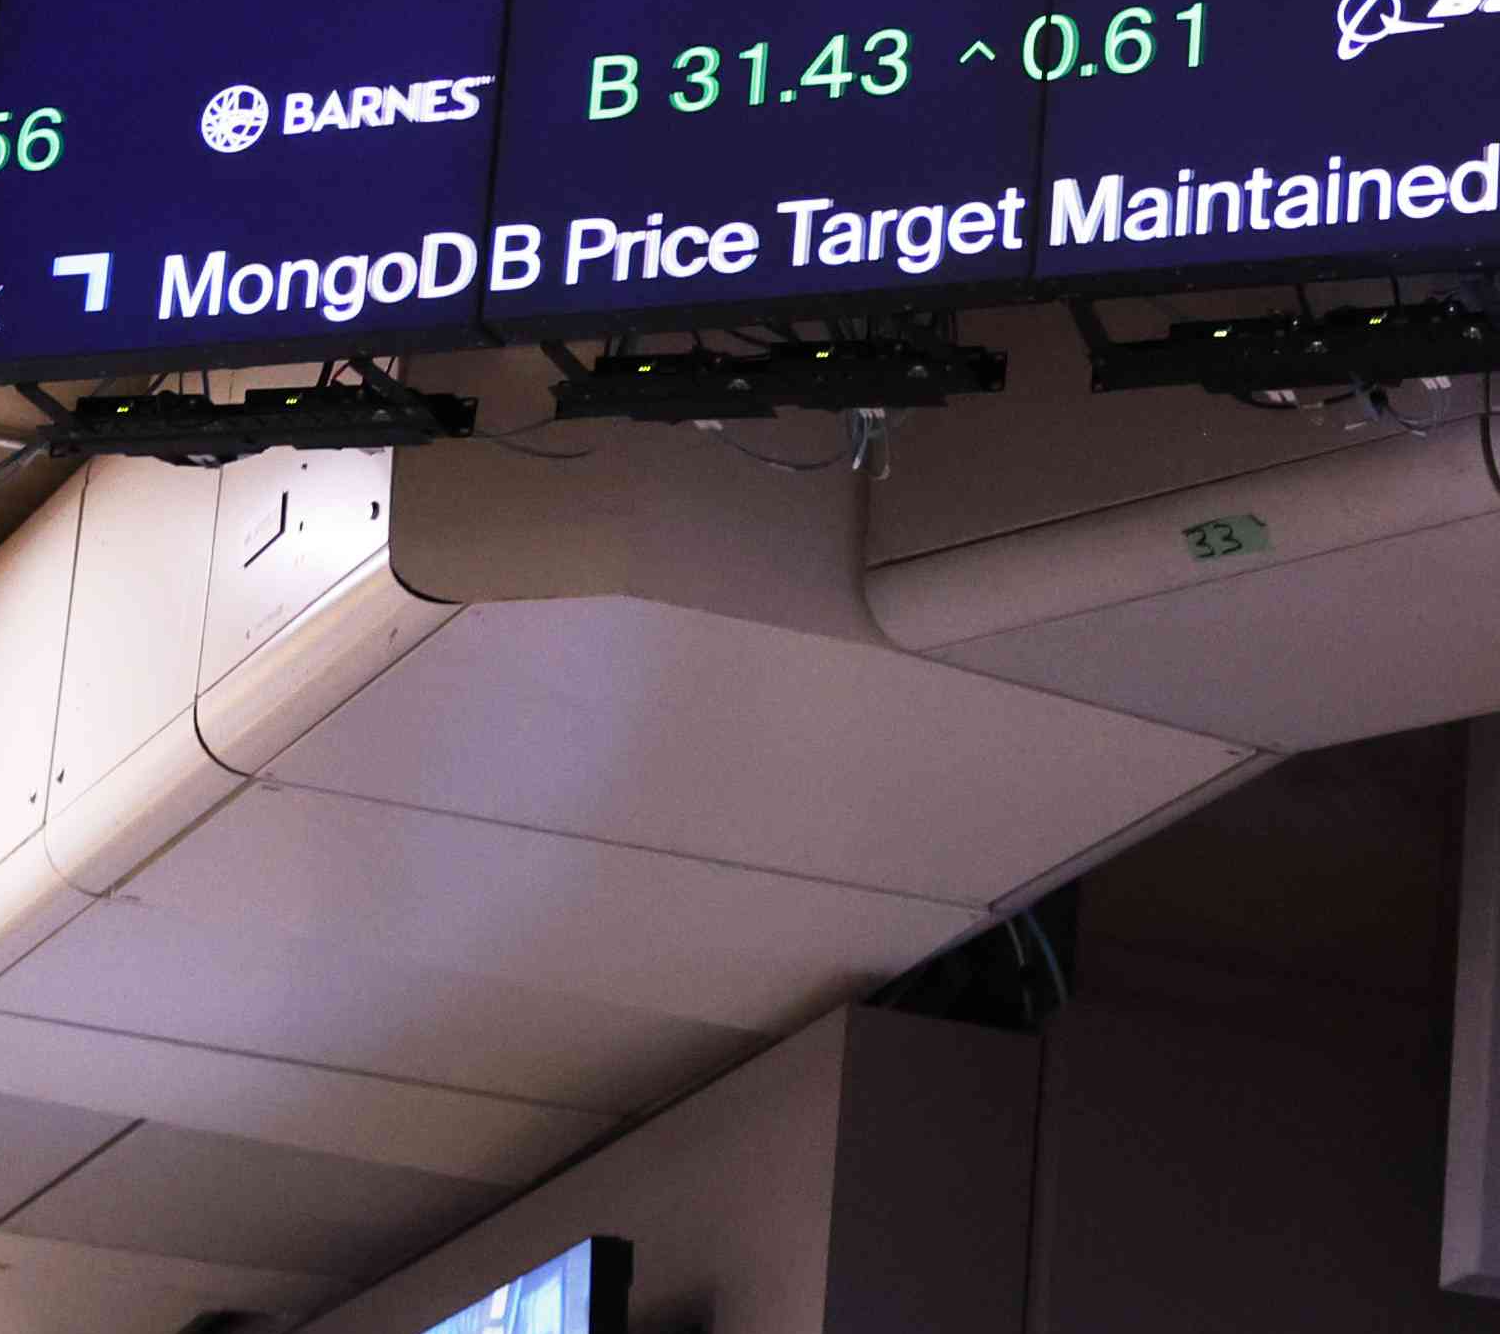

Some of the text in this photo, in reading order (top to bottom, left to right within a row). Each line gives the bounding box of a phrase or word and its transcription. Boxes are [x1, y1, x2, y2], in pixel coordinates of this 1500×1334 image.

[283, 76, 484, 134] BARNES
[589, 3, 1202, 120] B 31.43 0.61
[565, 213, 759, 285] Price
[777, 188, 1025, 273] Target
[1050, 143, 1500, 246] Maintained
